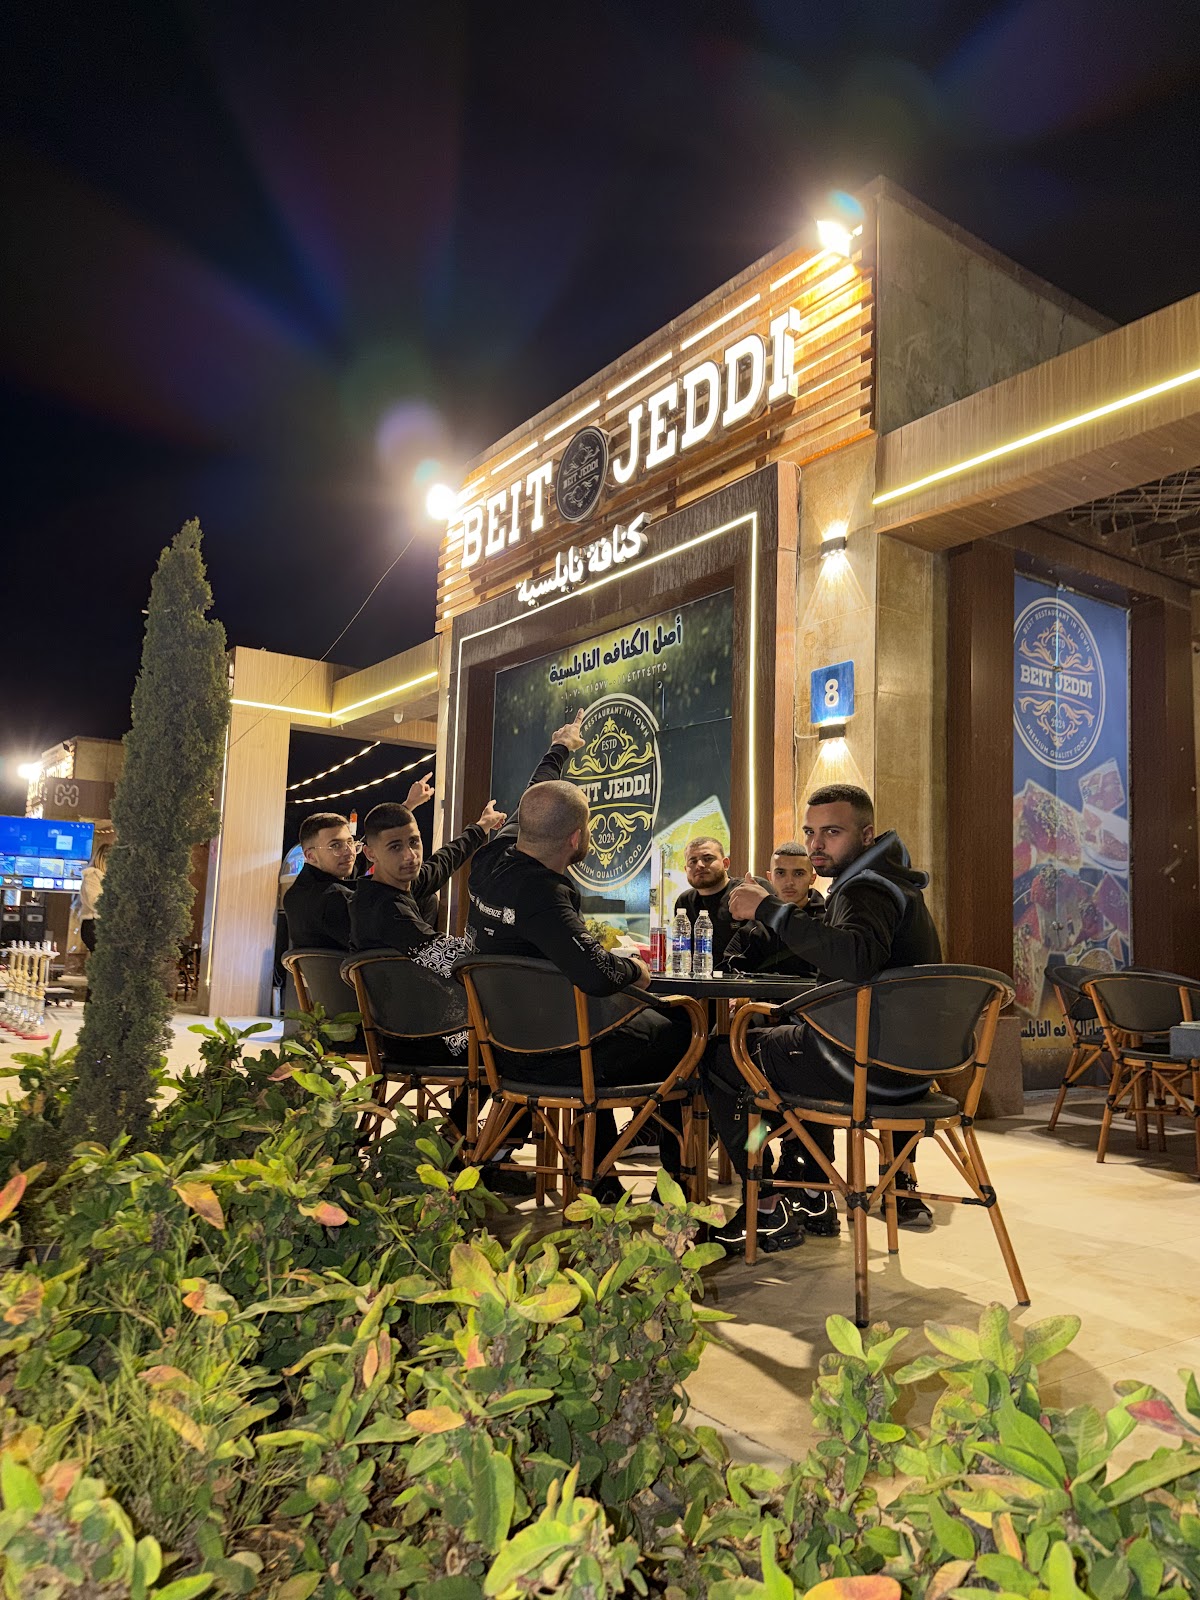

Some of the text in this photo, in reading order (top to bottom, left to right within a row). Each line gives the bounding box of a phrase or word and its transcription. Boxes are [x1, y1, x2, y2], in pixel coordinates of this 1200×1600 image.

[460, 307, 796, 569] BEIT JEDDI
[516, 512, 650, 606] كنافة نابلسية
[652, 615, 682, 655] أصل
[1051, 636, 1066, 649] ETD
[549, 647, 600, 686] النابلسية
[1020, 664, 1093, 699] BEIT JEDDI
[825, 678, 840, 707] 8
[584, 706, 650, 737] RESTAURANT IN TOWN
[601, 738, 617, 751] ESTD
[1025, 724, 1049, 754] PREMIUM
[579, 773, 651, 803] IT JEDDI
[597, 832, 616, 844] 2024
[577, 844, 642, 879] MIUM QUALITY FOOD
